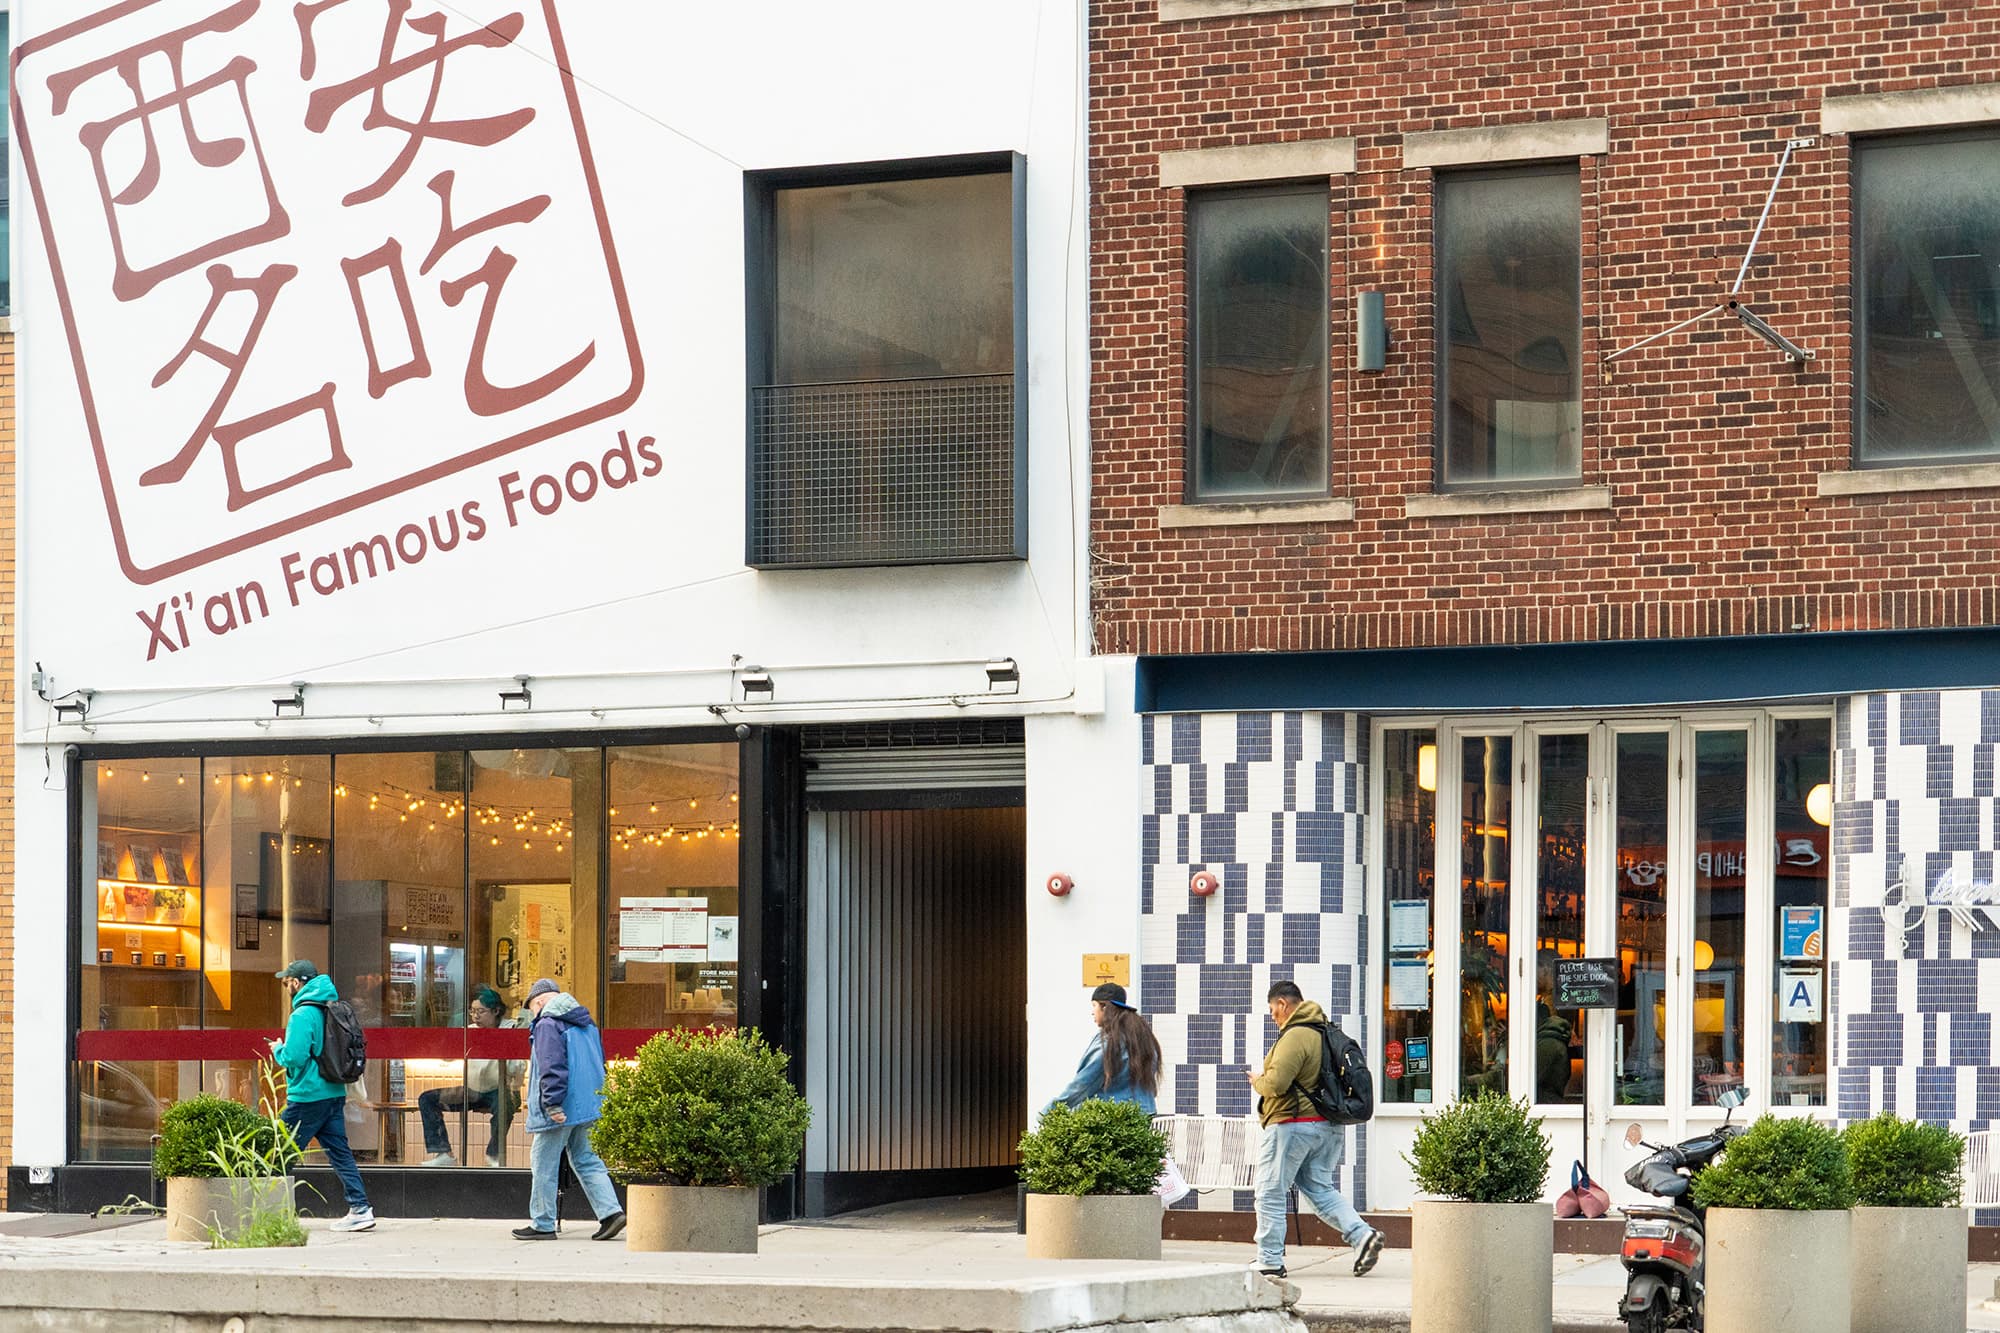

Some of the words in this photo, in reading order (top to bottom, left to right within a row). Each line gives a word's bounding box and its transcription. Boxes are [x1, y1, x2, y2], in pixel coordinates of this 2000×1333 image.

[137, 582, 270, 660] Xi'an
[281, 502, 487, 605] Famous
[499, 429, 663, 527] Foods
[1559, 963, 1585, 973] PLEASE
[1587, 962, 1603, 972] USE
[1559, 974, 1573, 983] THE
[1573, 974, 1588, 982] SIDE
[1589, 972, 1609, 983] DOOR
[1560, 991, 1569, 1002] &
[1789, 980, 1812, 1007] A
